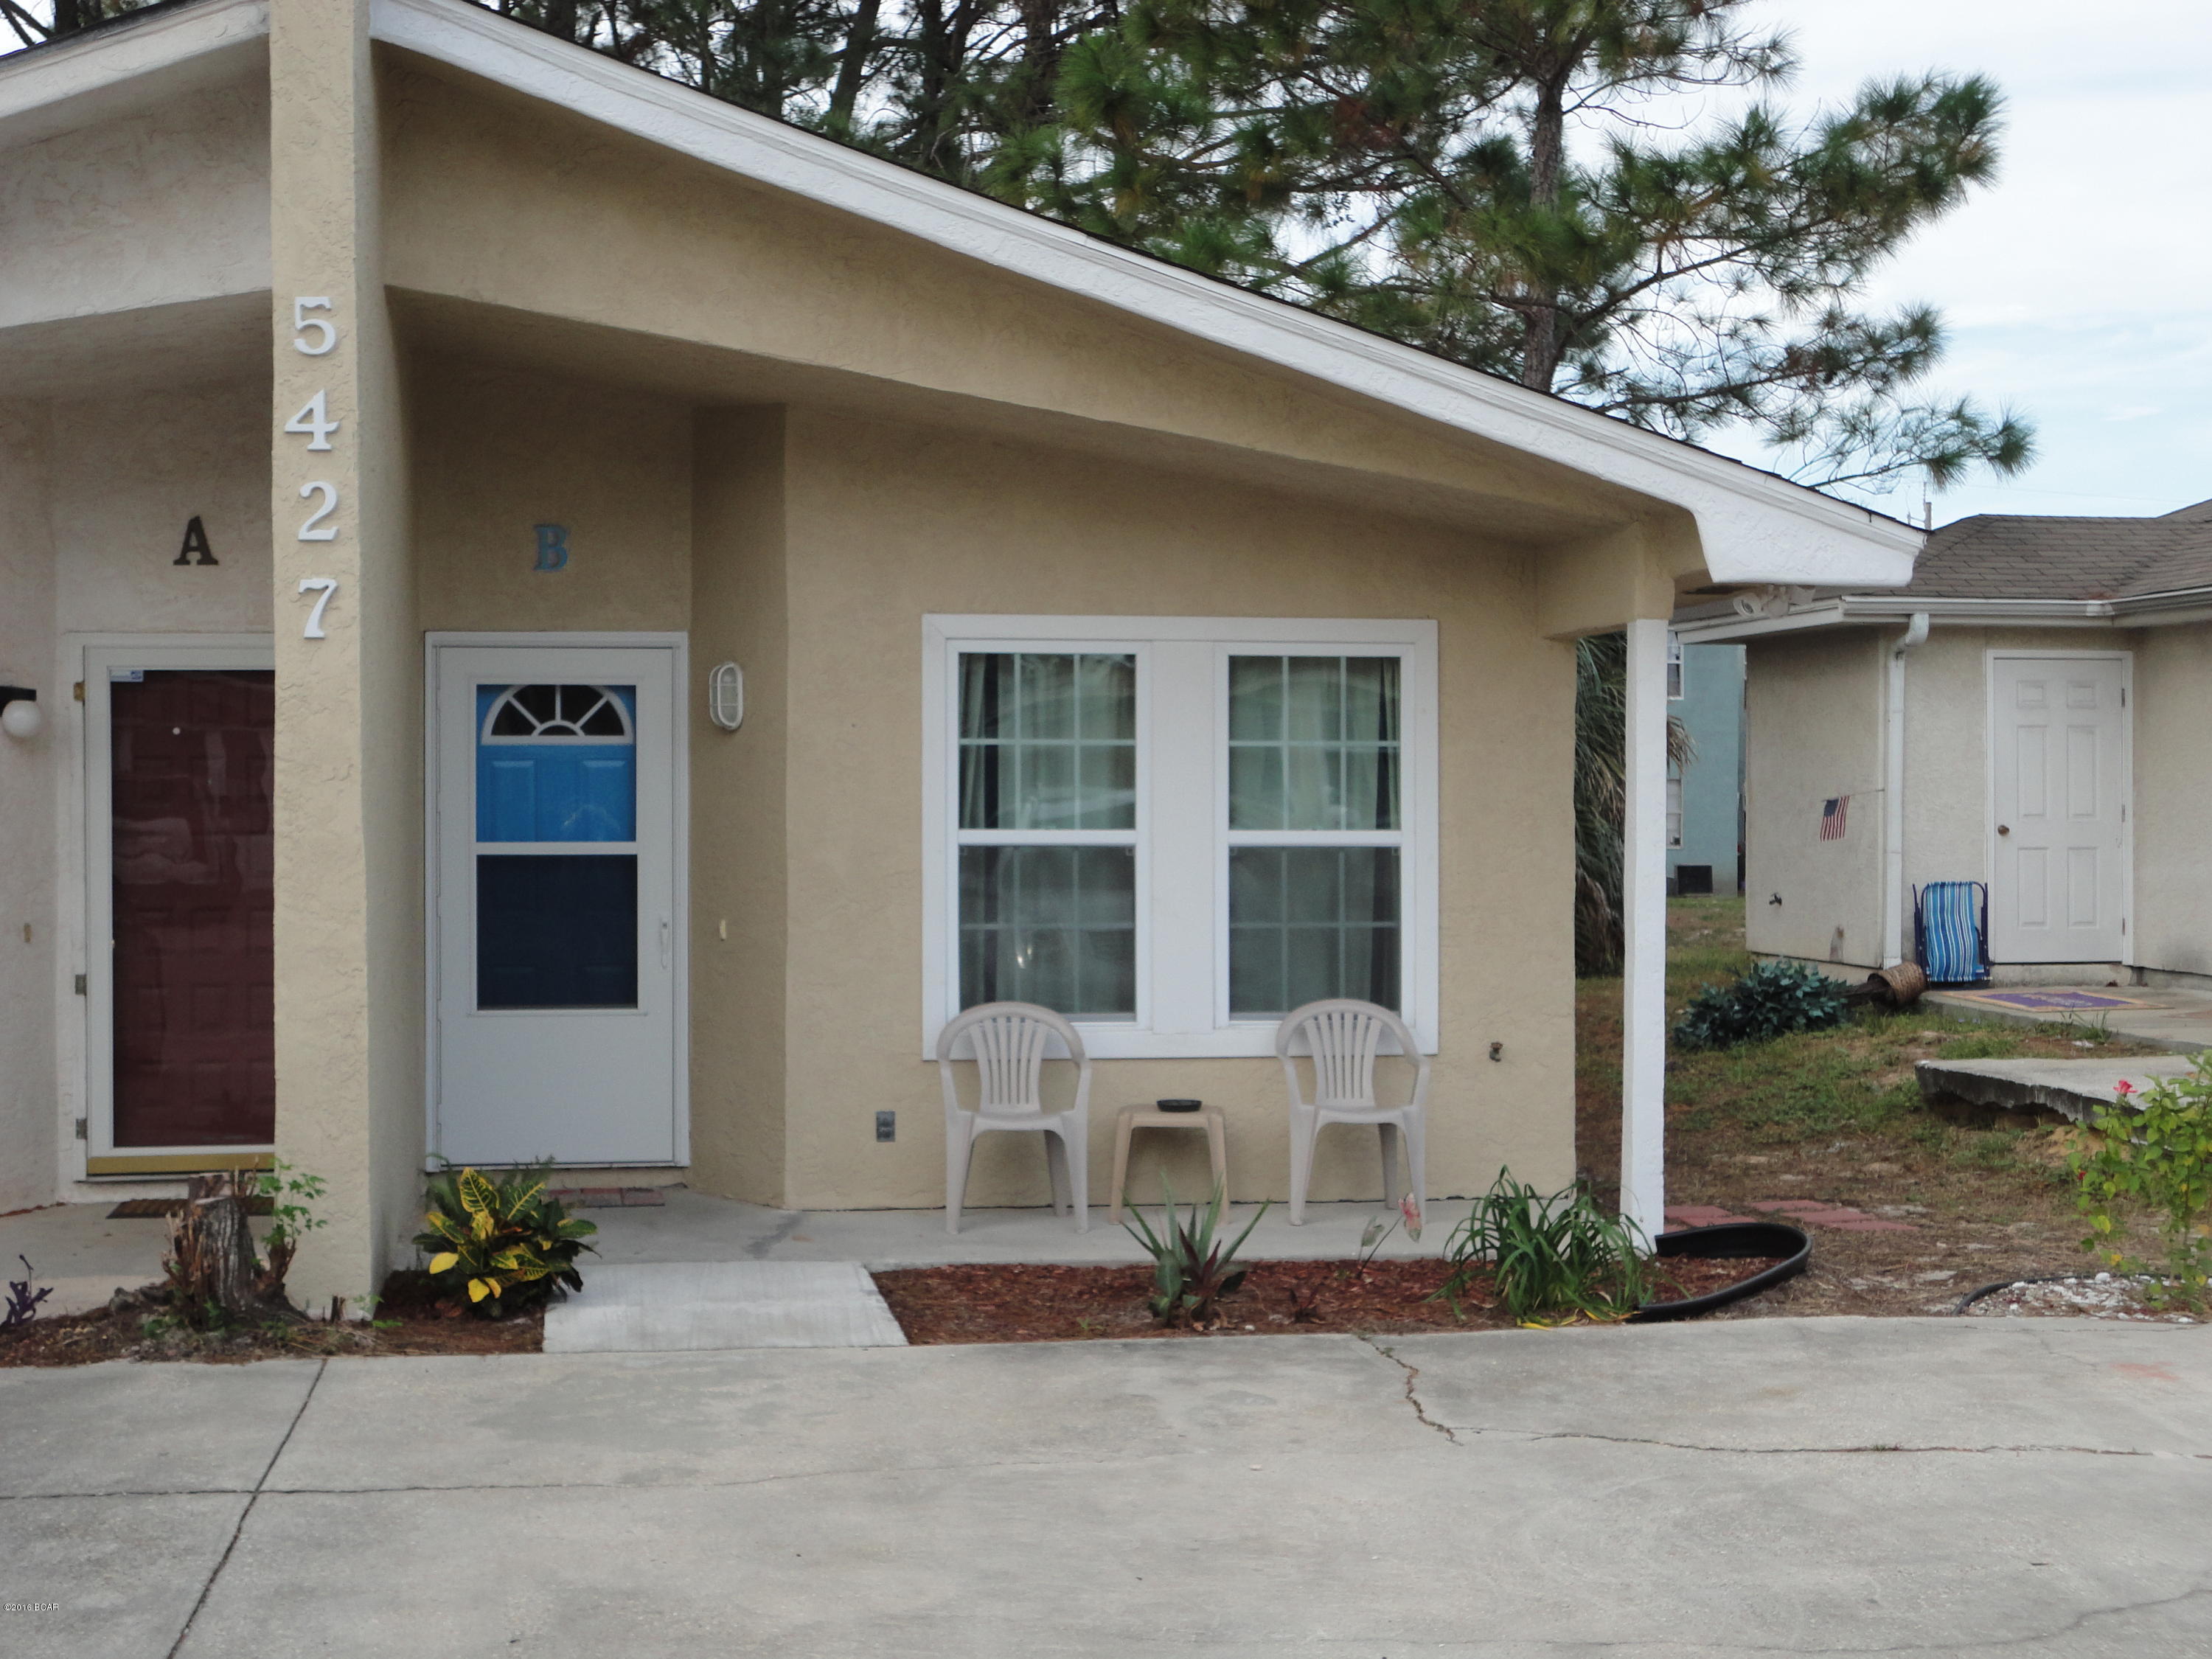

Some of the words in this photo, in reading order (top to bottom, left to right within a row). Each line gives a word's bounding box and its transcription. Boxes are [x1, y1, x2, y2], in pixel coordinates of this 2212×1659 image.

[284, 296, 340, 639] 5427
[173, 515, 219, 566] A
[532, 523, 571, 572] B
